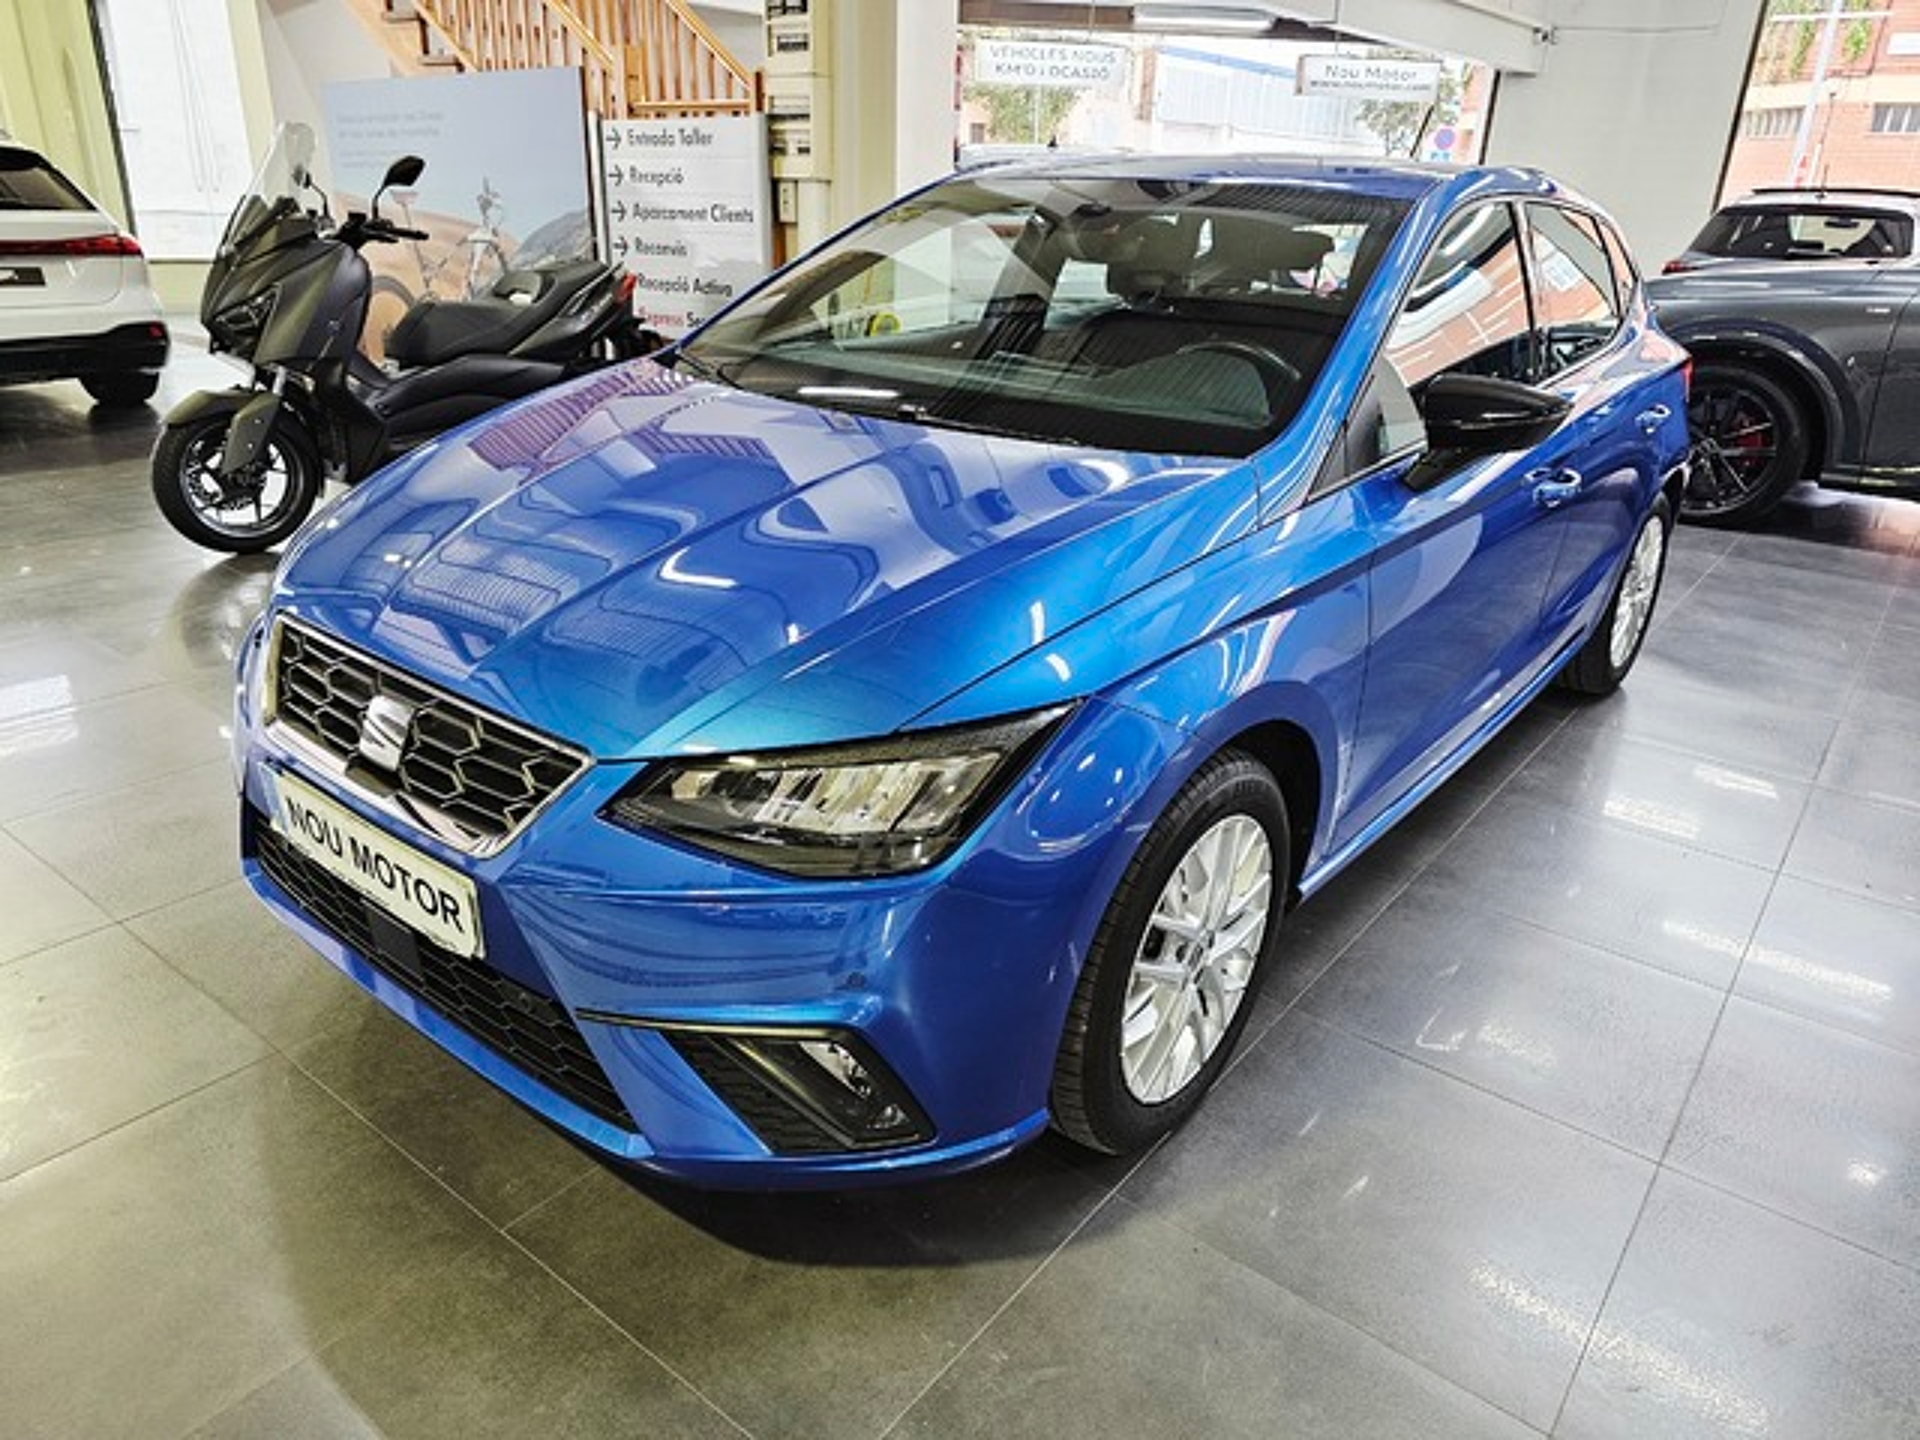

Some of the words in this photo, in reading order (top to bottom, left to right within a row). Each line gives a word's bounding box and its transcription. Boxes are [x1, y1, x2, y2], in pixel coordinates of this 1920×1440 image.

[1325, 64, 1359, 78] Nou
[1365, 66, 1417, 81] Motor
[627, 128, 675, 146] Entrada
[678, 127, 713, 146] Taller
[630, 166, 684, 186] Recepció
[632, 203, 708, 222] Aparcament
[710, 203, 754, 222] Clients
[635, 237, 688, 257] Recanvis
[639, 272, 690, 294] Recepció
[284, 795, 344, 857] NOU
[348, 835, 466, 934] MOTOR
